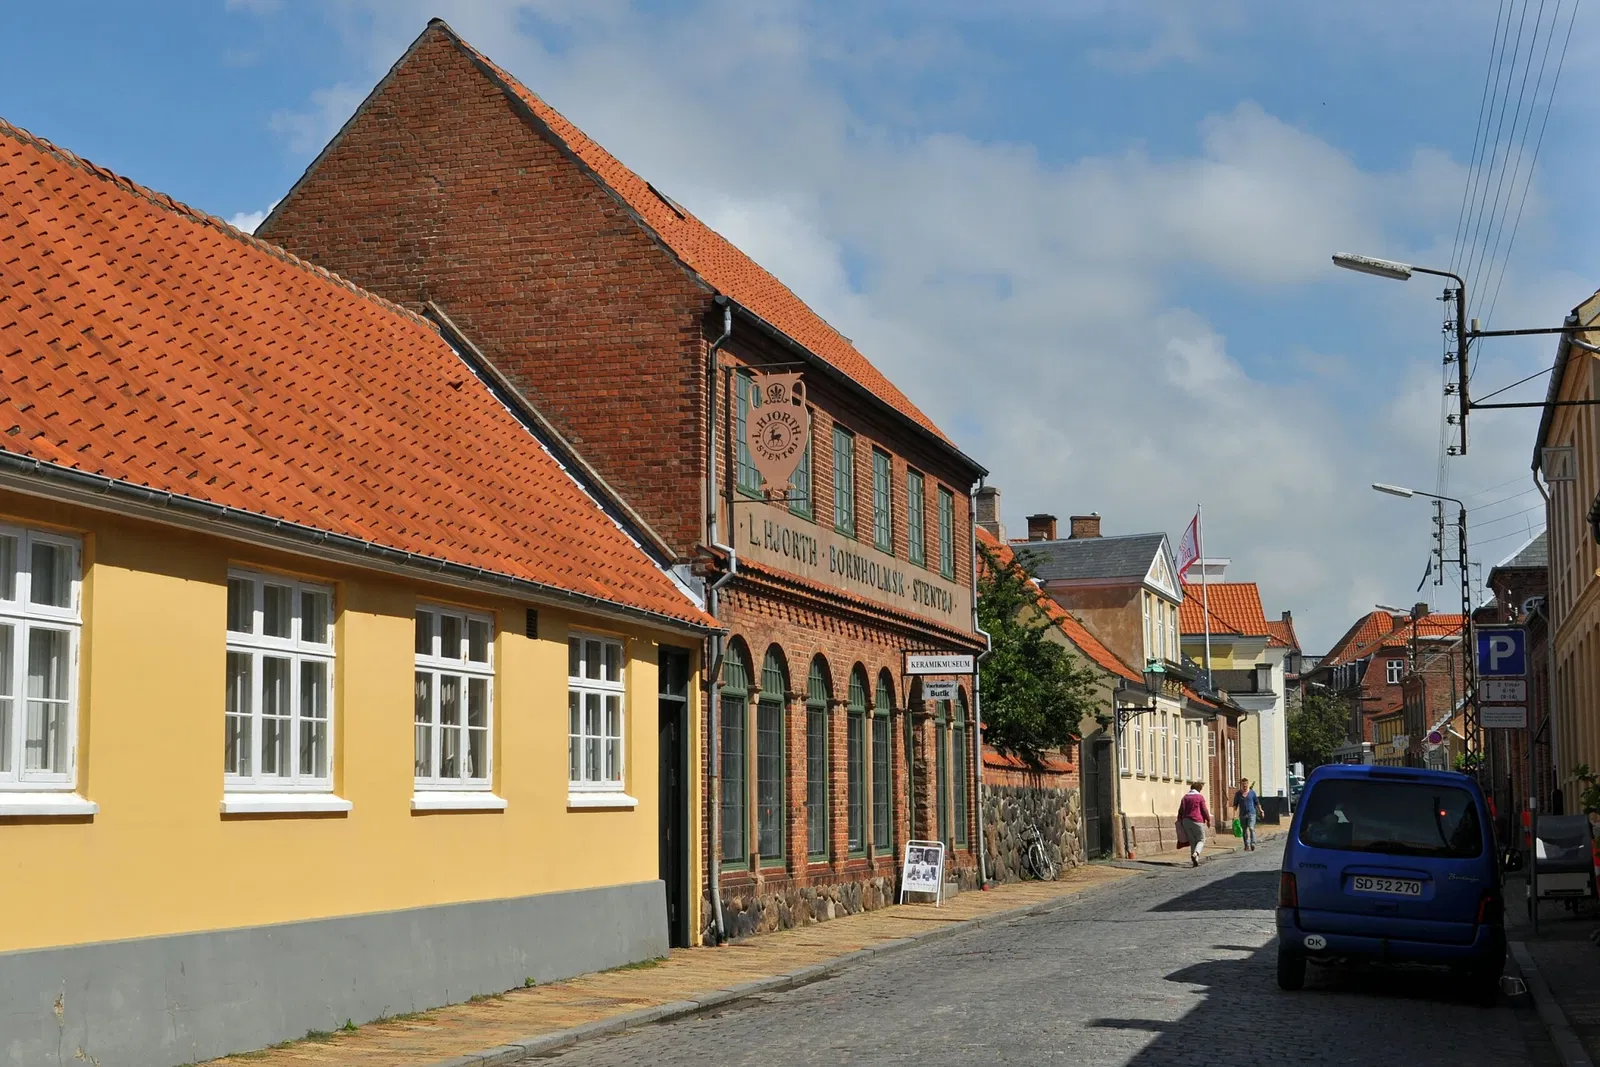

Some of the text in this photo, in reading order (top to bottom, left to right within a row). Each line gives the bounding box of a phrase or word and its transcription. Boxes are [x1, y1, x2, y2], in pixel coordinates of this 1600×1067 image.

[756, 442, 798, 461] STENTØJ
[763, 519, 818, 567] HJORTH
[829, 544, 905, 598] BORNHOLMSK
[912, 578, 952, 614] STENTØJ
[1489, 635, 1516, 671] P
[910, 660, 970, 669] KERAMIKMUSEUM
[1355, 878, 1420, 894] SD 52 270
[1307, 937, 1323, 947] DK
